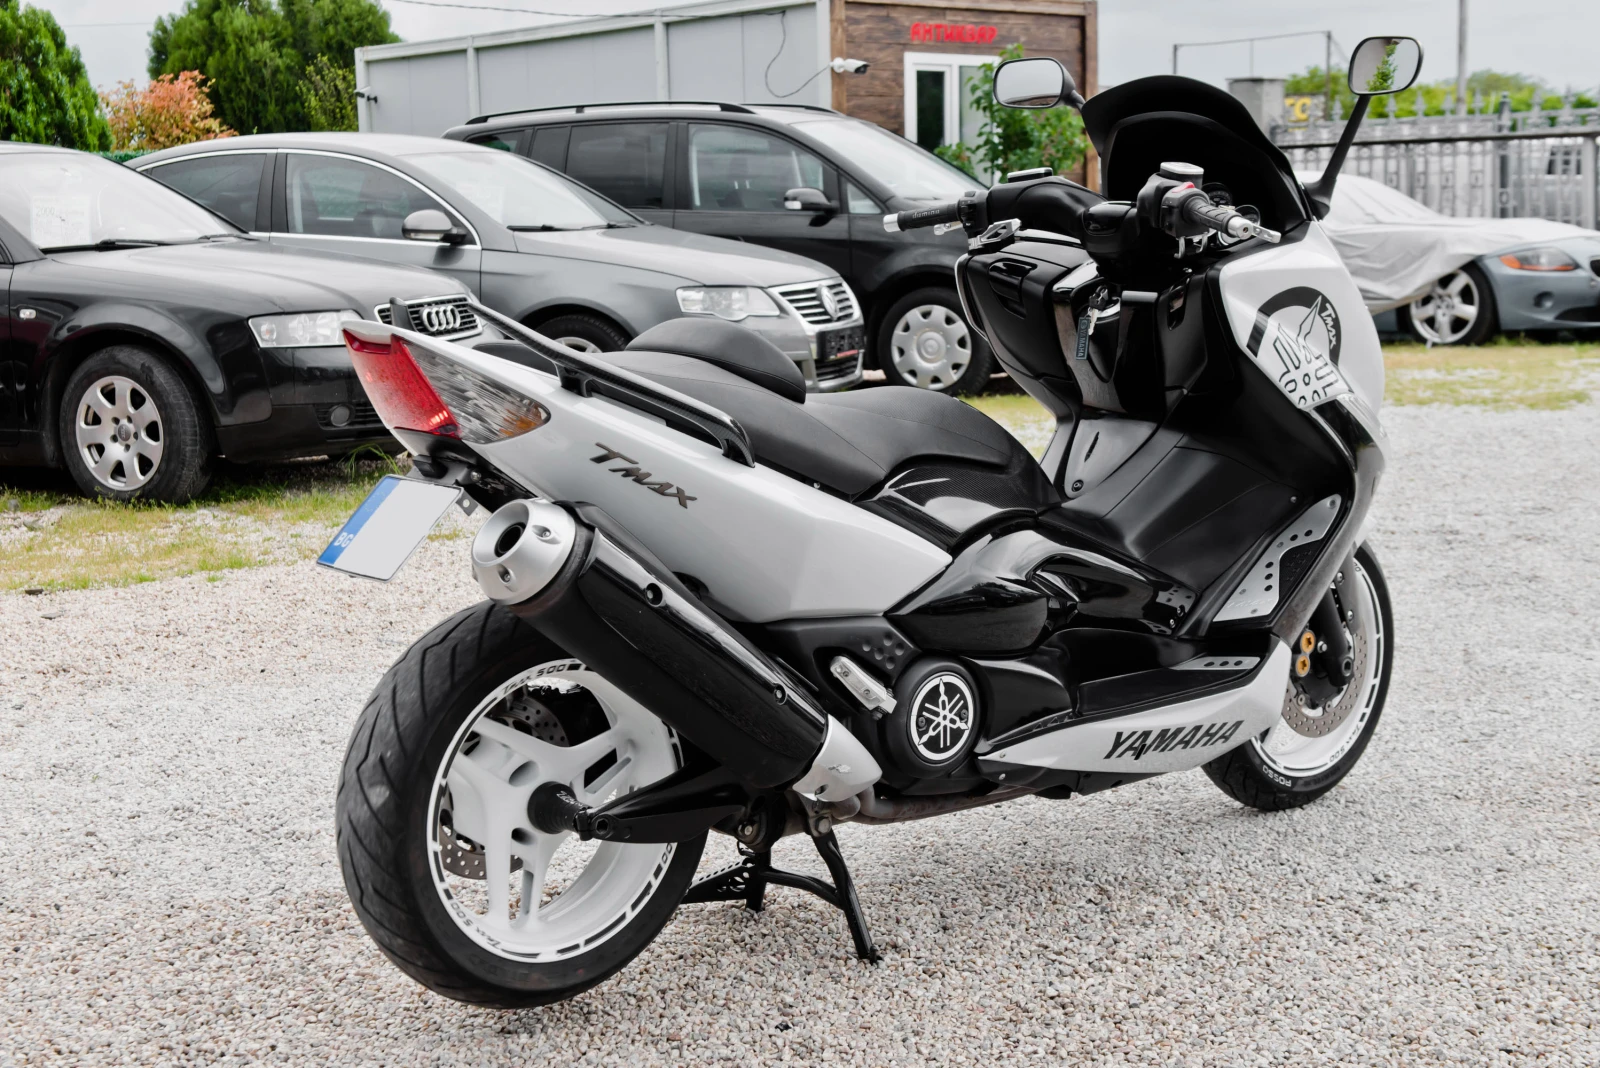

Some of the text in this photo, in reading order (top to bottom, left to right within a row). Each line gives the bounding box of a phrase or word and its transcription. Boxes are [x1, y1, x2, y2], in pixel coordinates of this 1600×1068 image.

[910, 22, 998, 44] АНТИКВАР
[1078, 329, 1087, 357] YAMAHA
[333, 532, 354, 548] BG
[537, 664, 567, 677] 500
[1103, 720, 1244, 759] YAMAHA
[1262, 765, 1292, 787] ROSSO
[450, 902, 474, 927] 500
